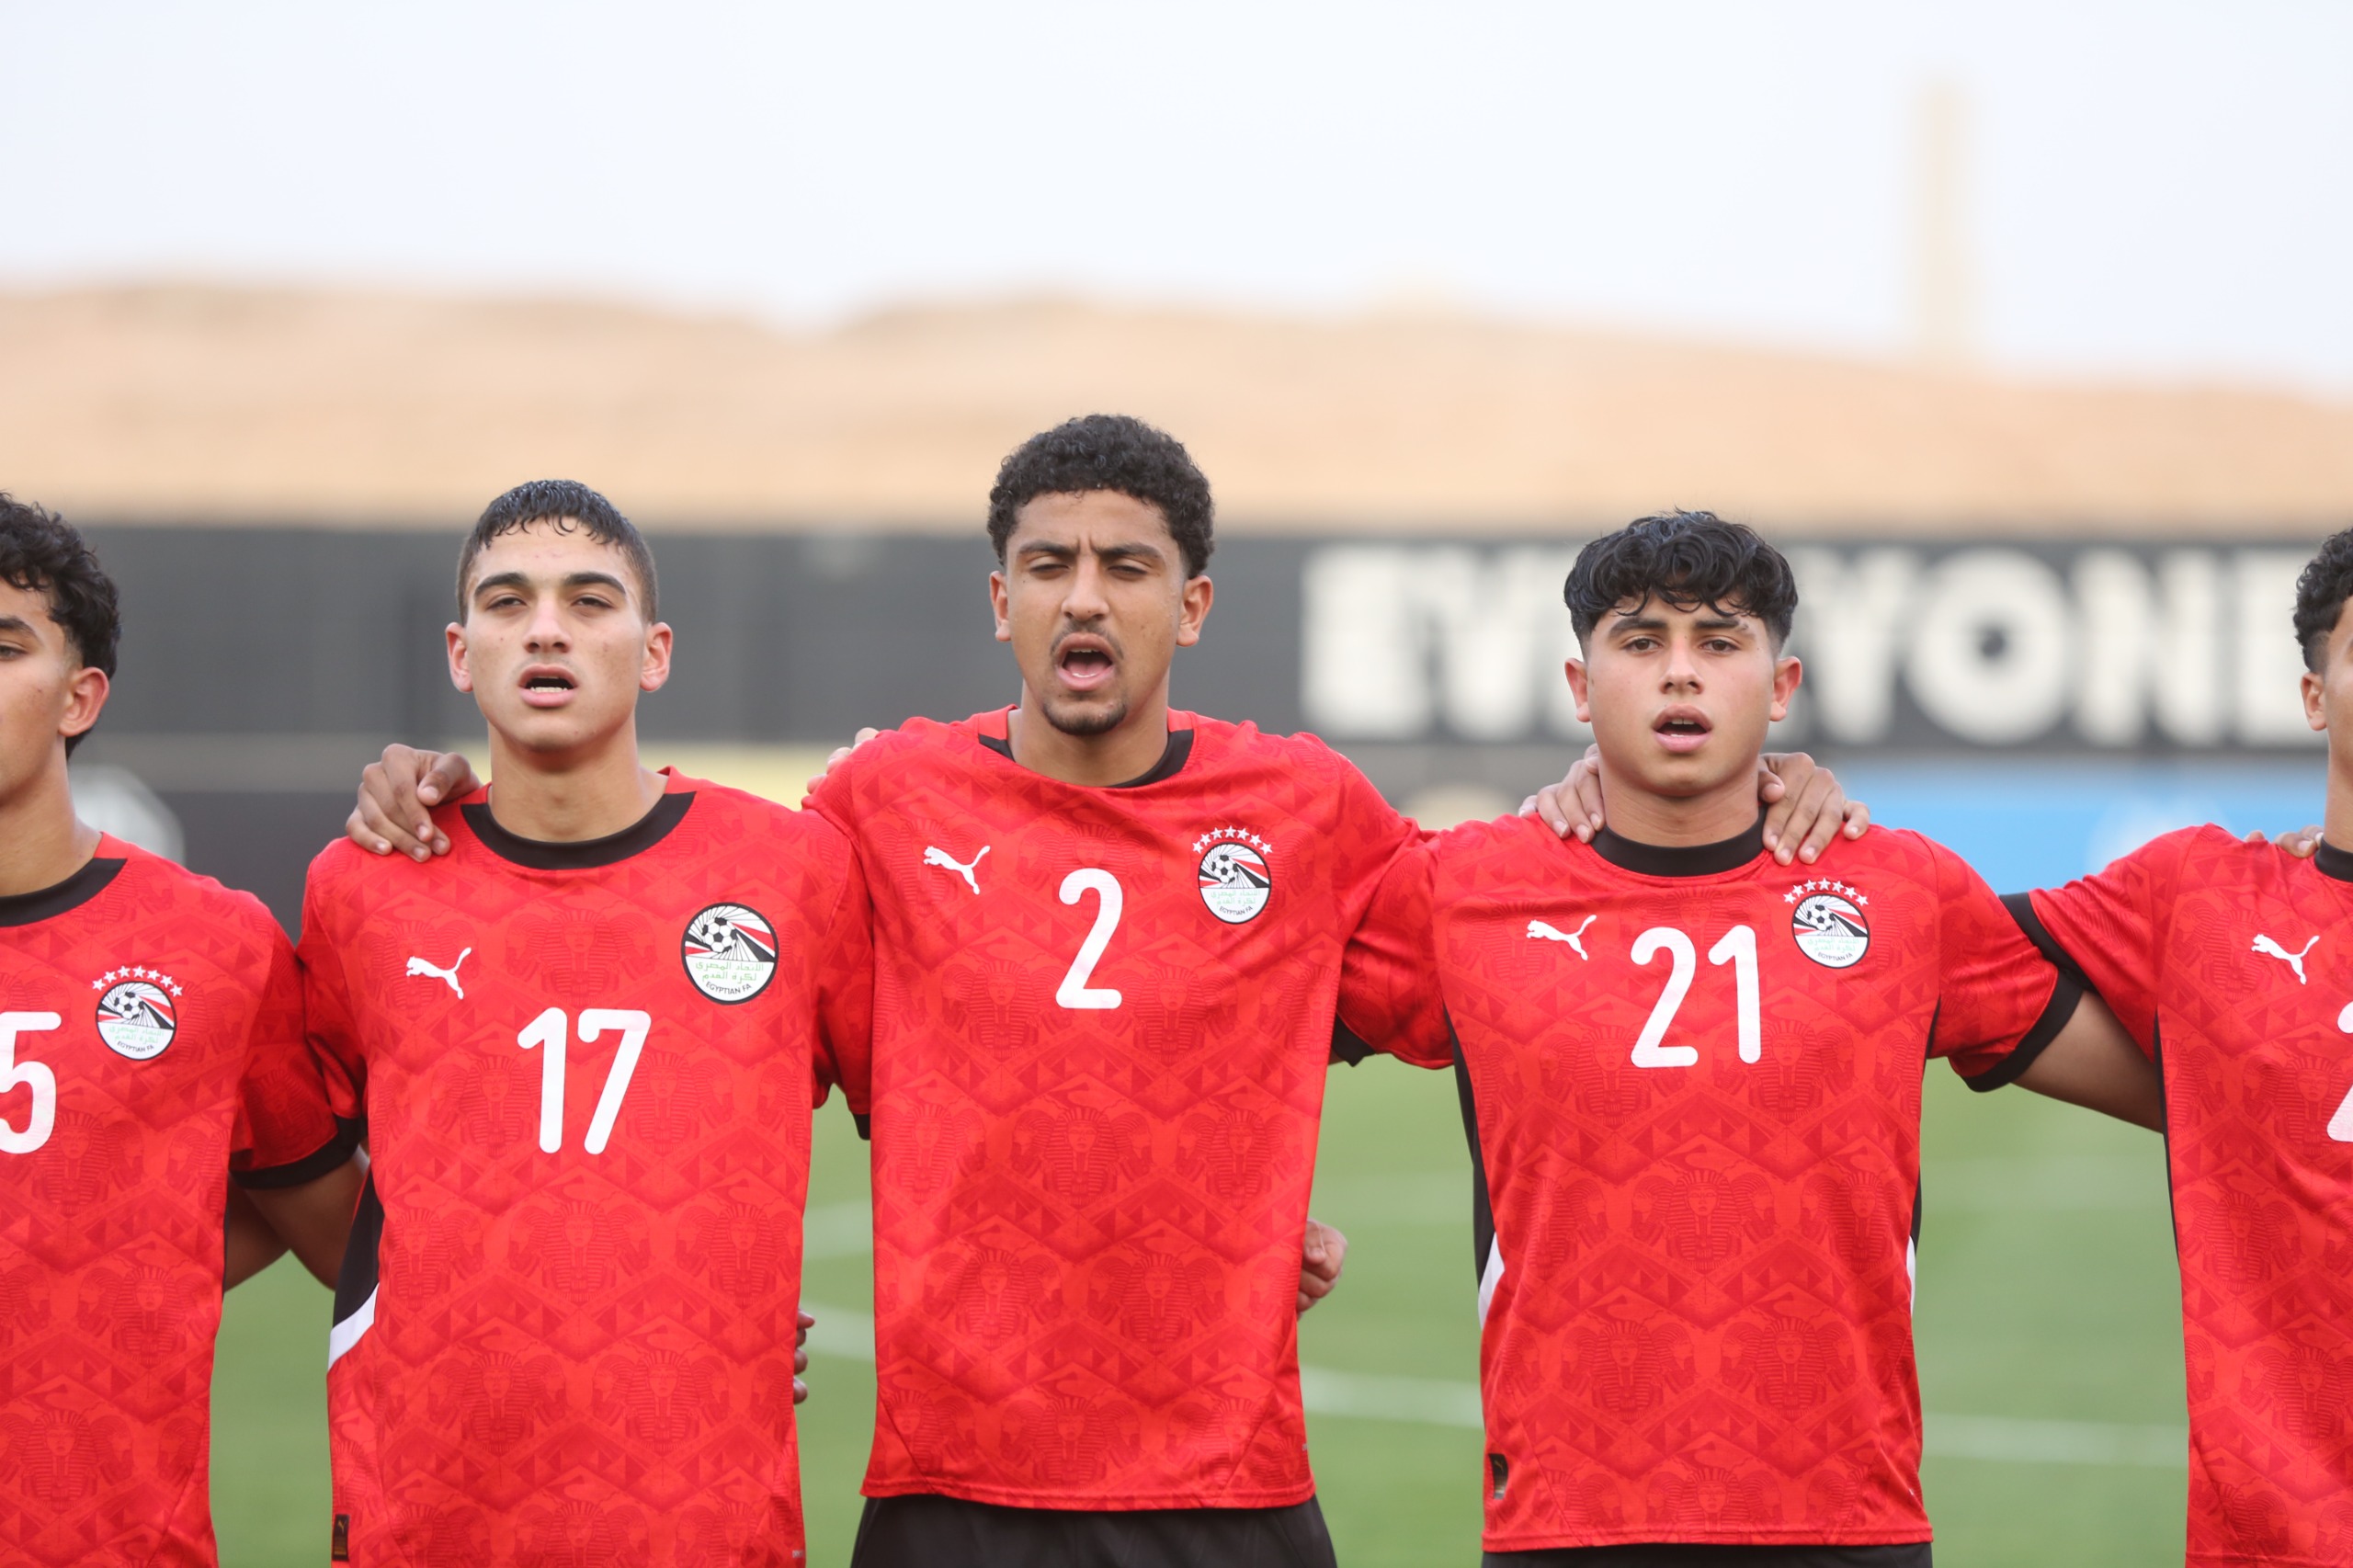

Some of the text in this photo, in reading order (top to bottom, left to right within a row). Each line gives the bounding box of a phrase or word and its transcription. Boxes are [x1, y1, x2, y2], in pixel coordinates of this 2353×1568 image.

[1301, 547, 2331, 744] EVYONE
[1056, 868, 1123, 1009] 2
[1219, 905, 1245, 915] EGYPTIAN
[705, 981, 753, 994] EGYPTIAN FA
[1817, 951, 1846, 961] EGYPTIAN
[1631, 925, 1761, 1068] 21
[117, 1040, 146, 1052] EGYPTIAN
[517, 1007, 652, 1154] 17
